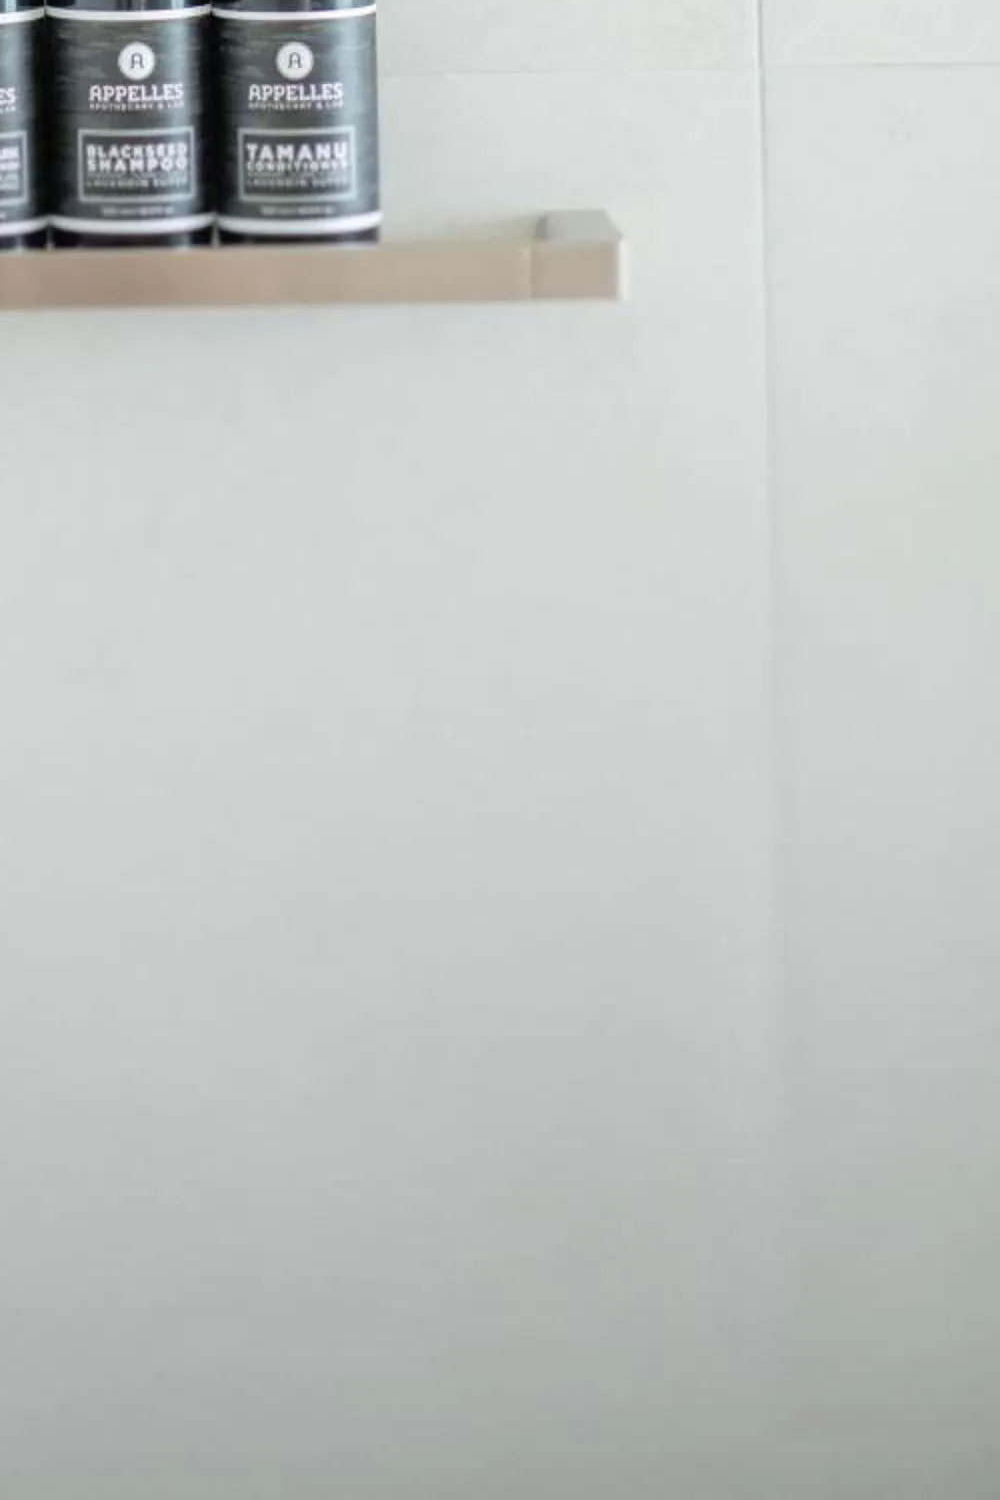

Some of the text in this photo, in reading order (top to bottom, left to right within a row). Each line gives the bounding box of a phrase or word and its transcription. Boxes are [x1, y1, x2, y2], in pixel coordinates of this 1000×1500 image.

[89, 83, 184, 102] APPELLES
[248, 82, 344, 101] APPELLES
[246, 141, 348, 160] TAMANU
[87, 156, 188, 172] SHAMPOO
